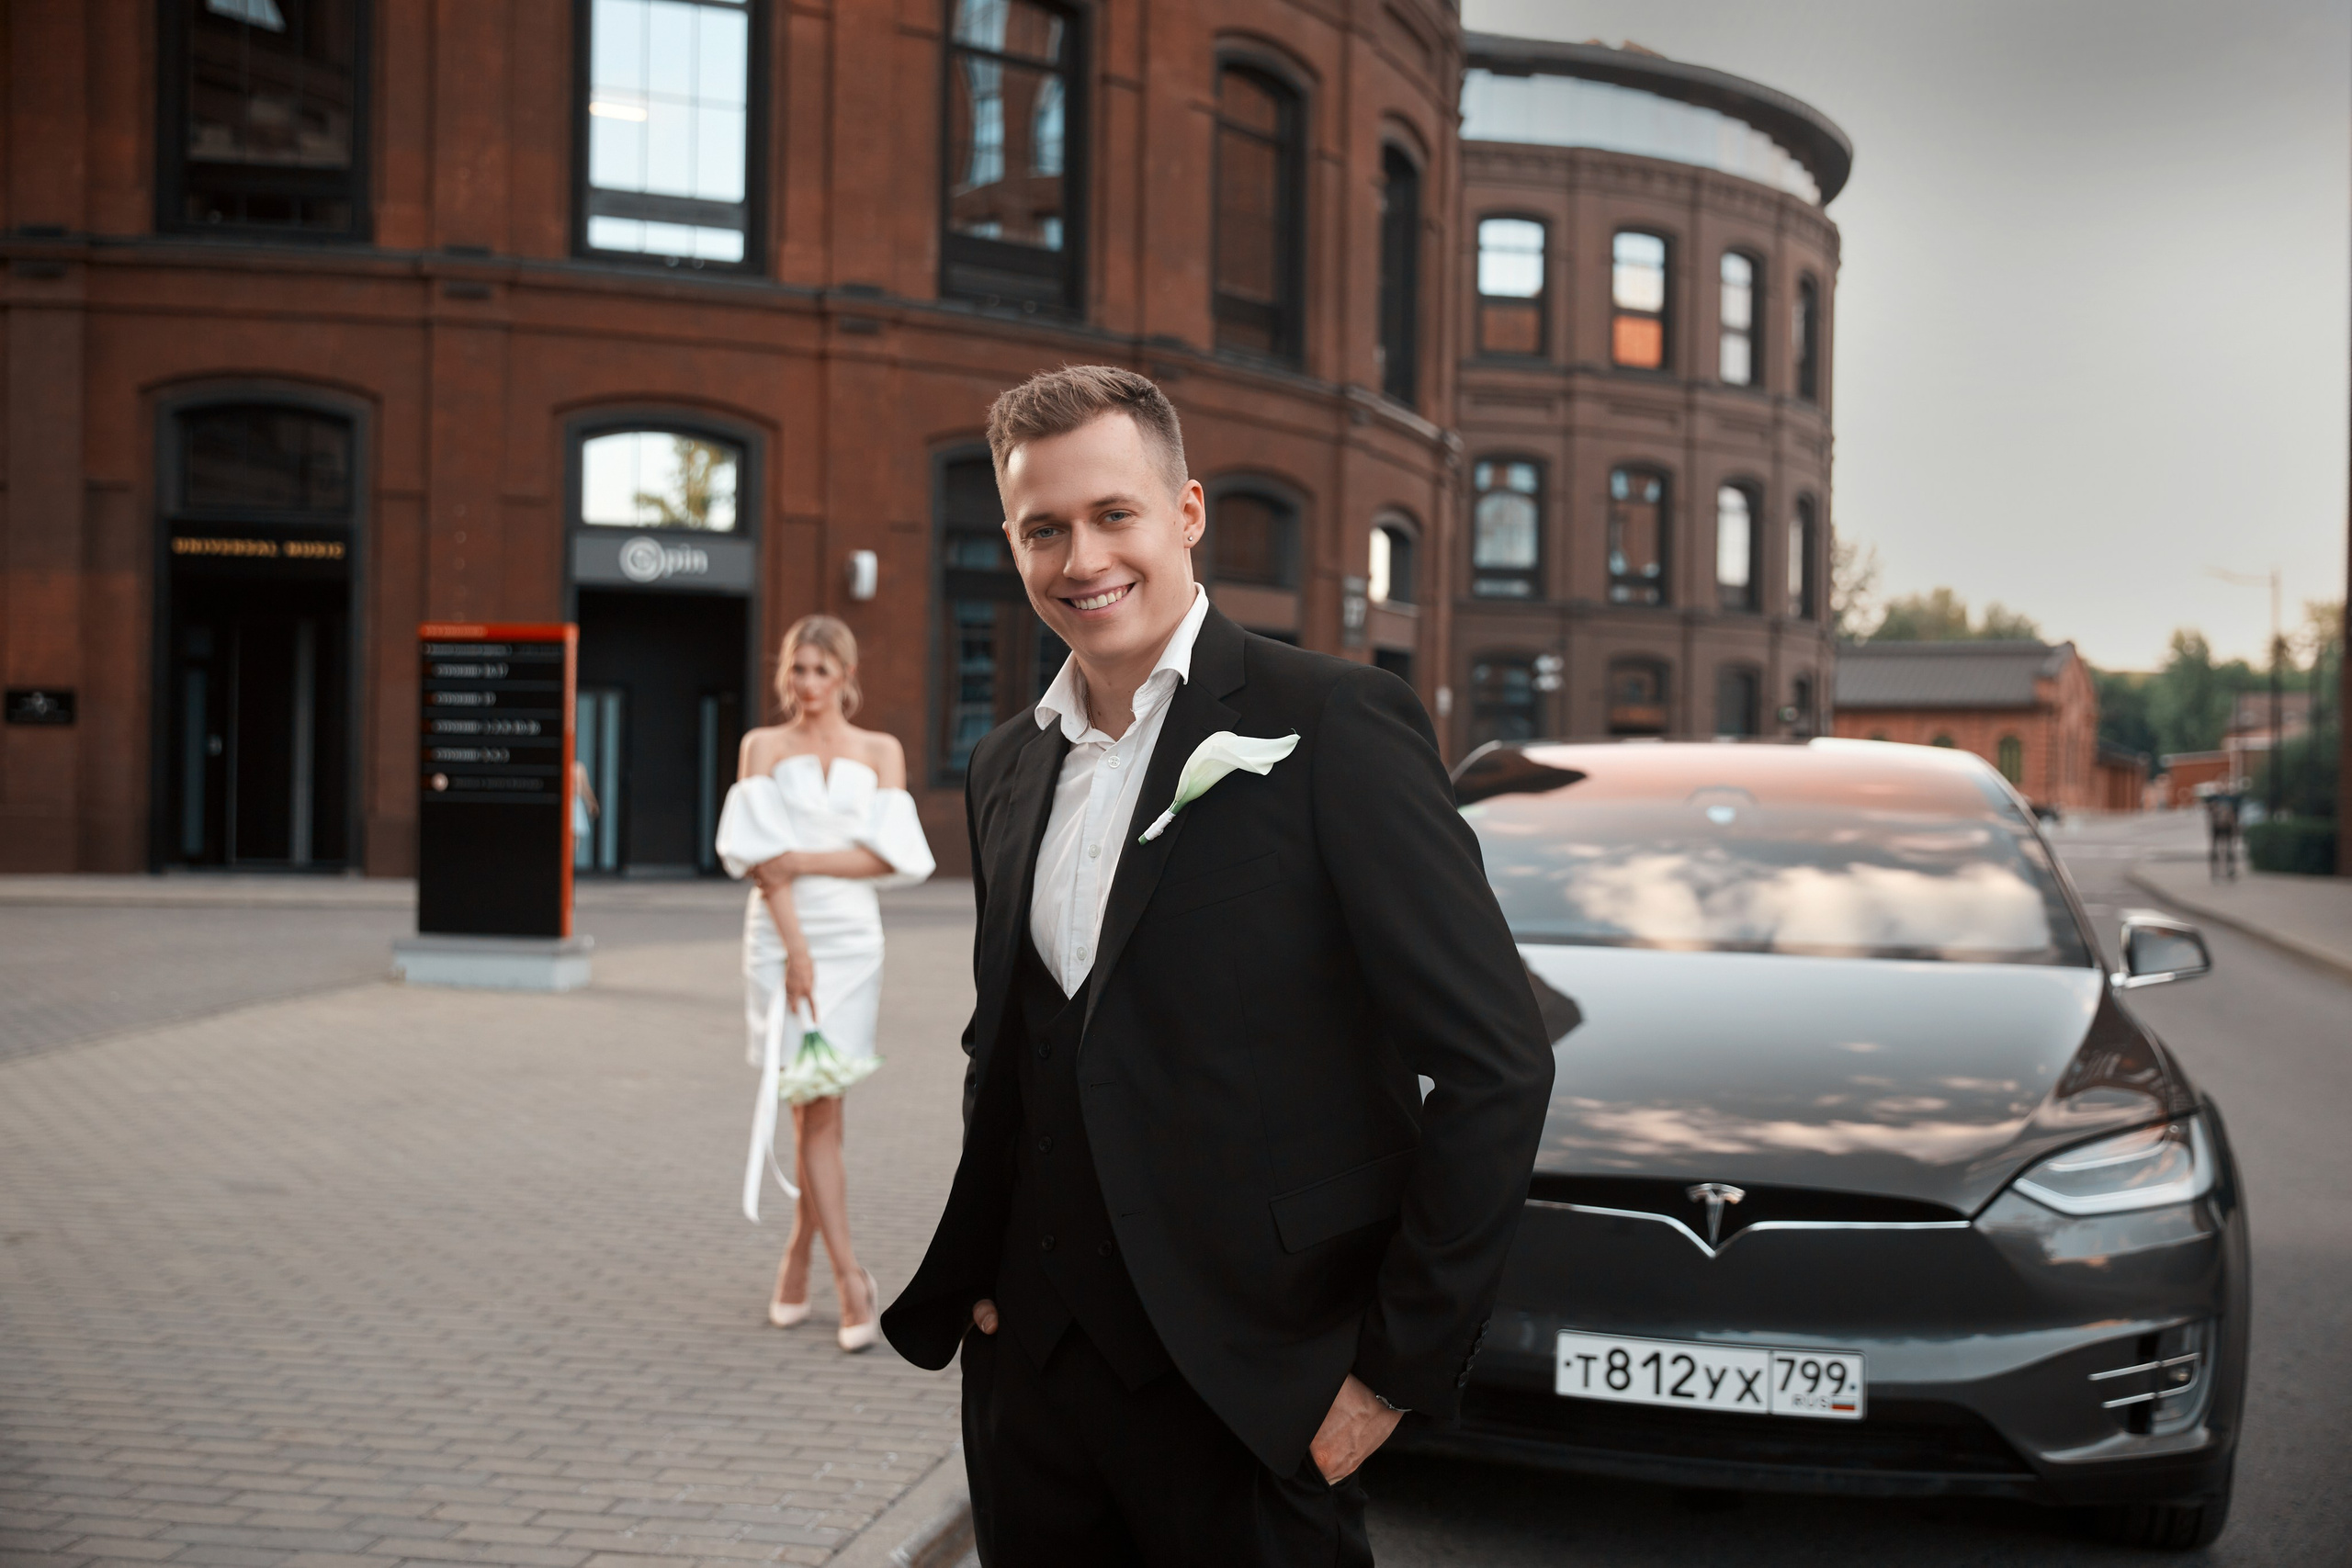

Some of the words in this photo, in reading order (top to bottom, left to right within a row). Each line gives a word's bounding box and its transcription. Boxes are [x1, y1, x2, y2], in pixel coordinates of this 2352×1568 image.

[172, 537, 278, 557] UNIVERSAL
[283, 540, 345, 559] MUSIC
[1776, 1358, 1847, 1394] 799
[1792, 1394, 1831, 1410] RUS
